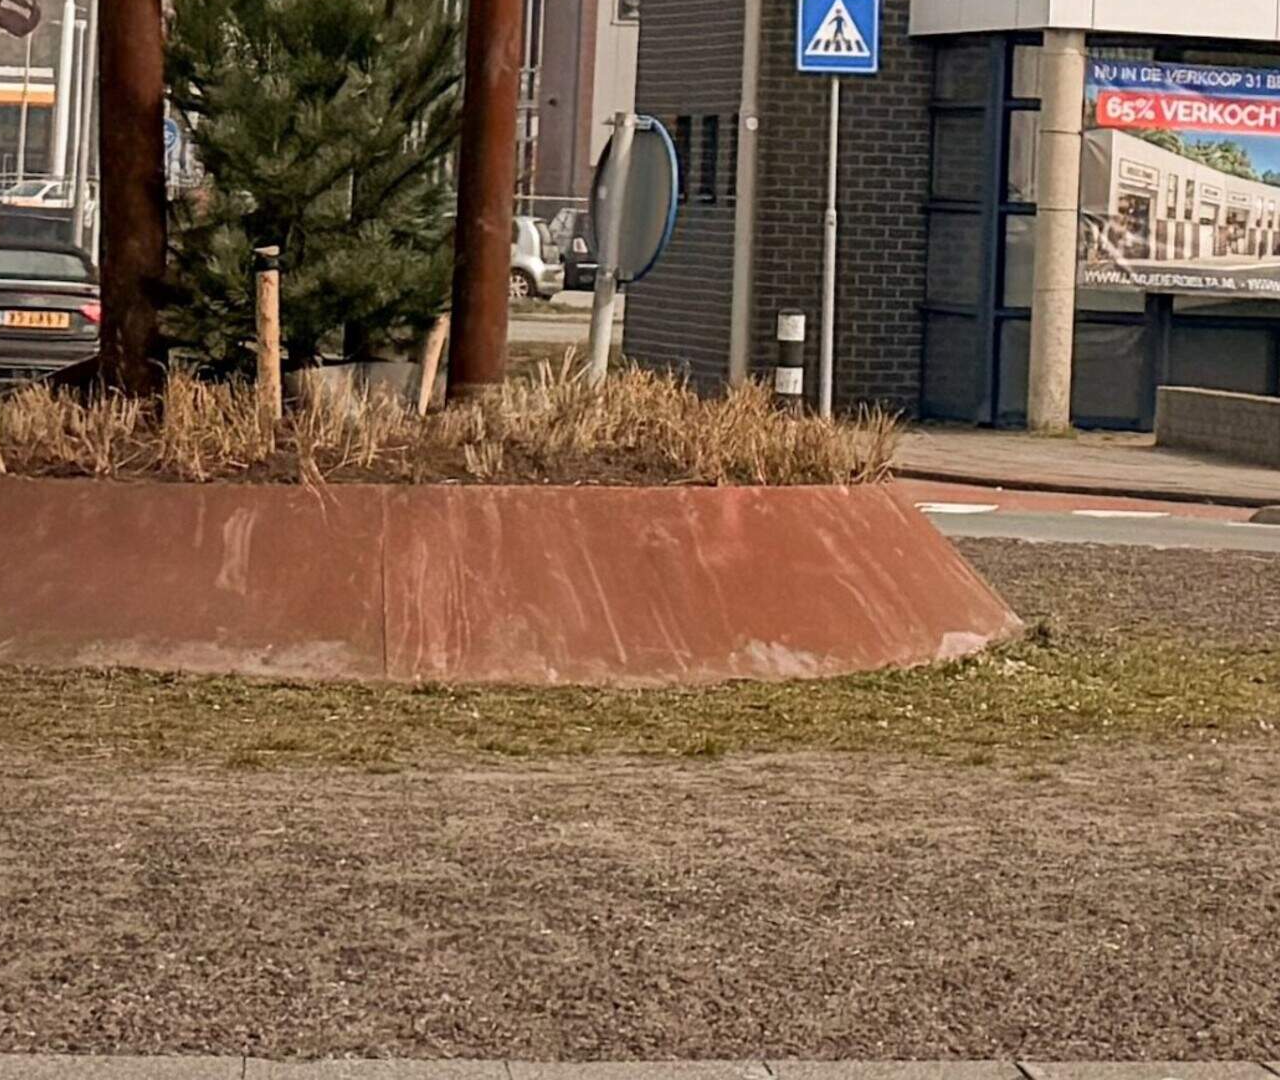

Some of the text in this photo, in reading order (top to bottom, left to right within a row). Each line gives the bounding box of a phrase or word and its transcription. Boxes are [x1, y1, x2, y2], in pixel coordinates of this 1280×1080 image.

[1094, 65, 1117, 81] NU
[1121, 67, 1137, 81] IN
[1141, 67, 1162, 83] DE
[1166, 69, 1241, 88] VERKOOP
[1245, 73, 1261, 89] 31
[1106, 96, 1156, 123] 65%
